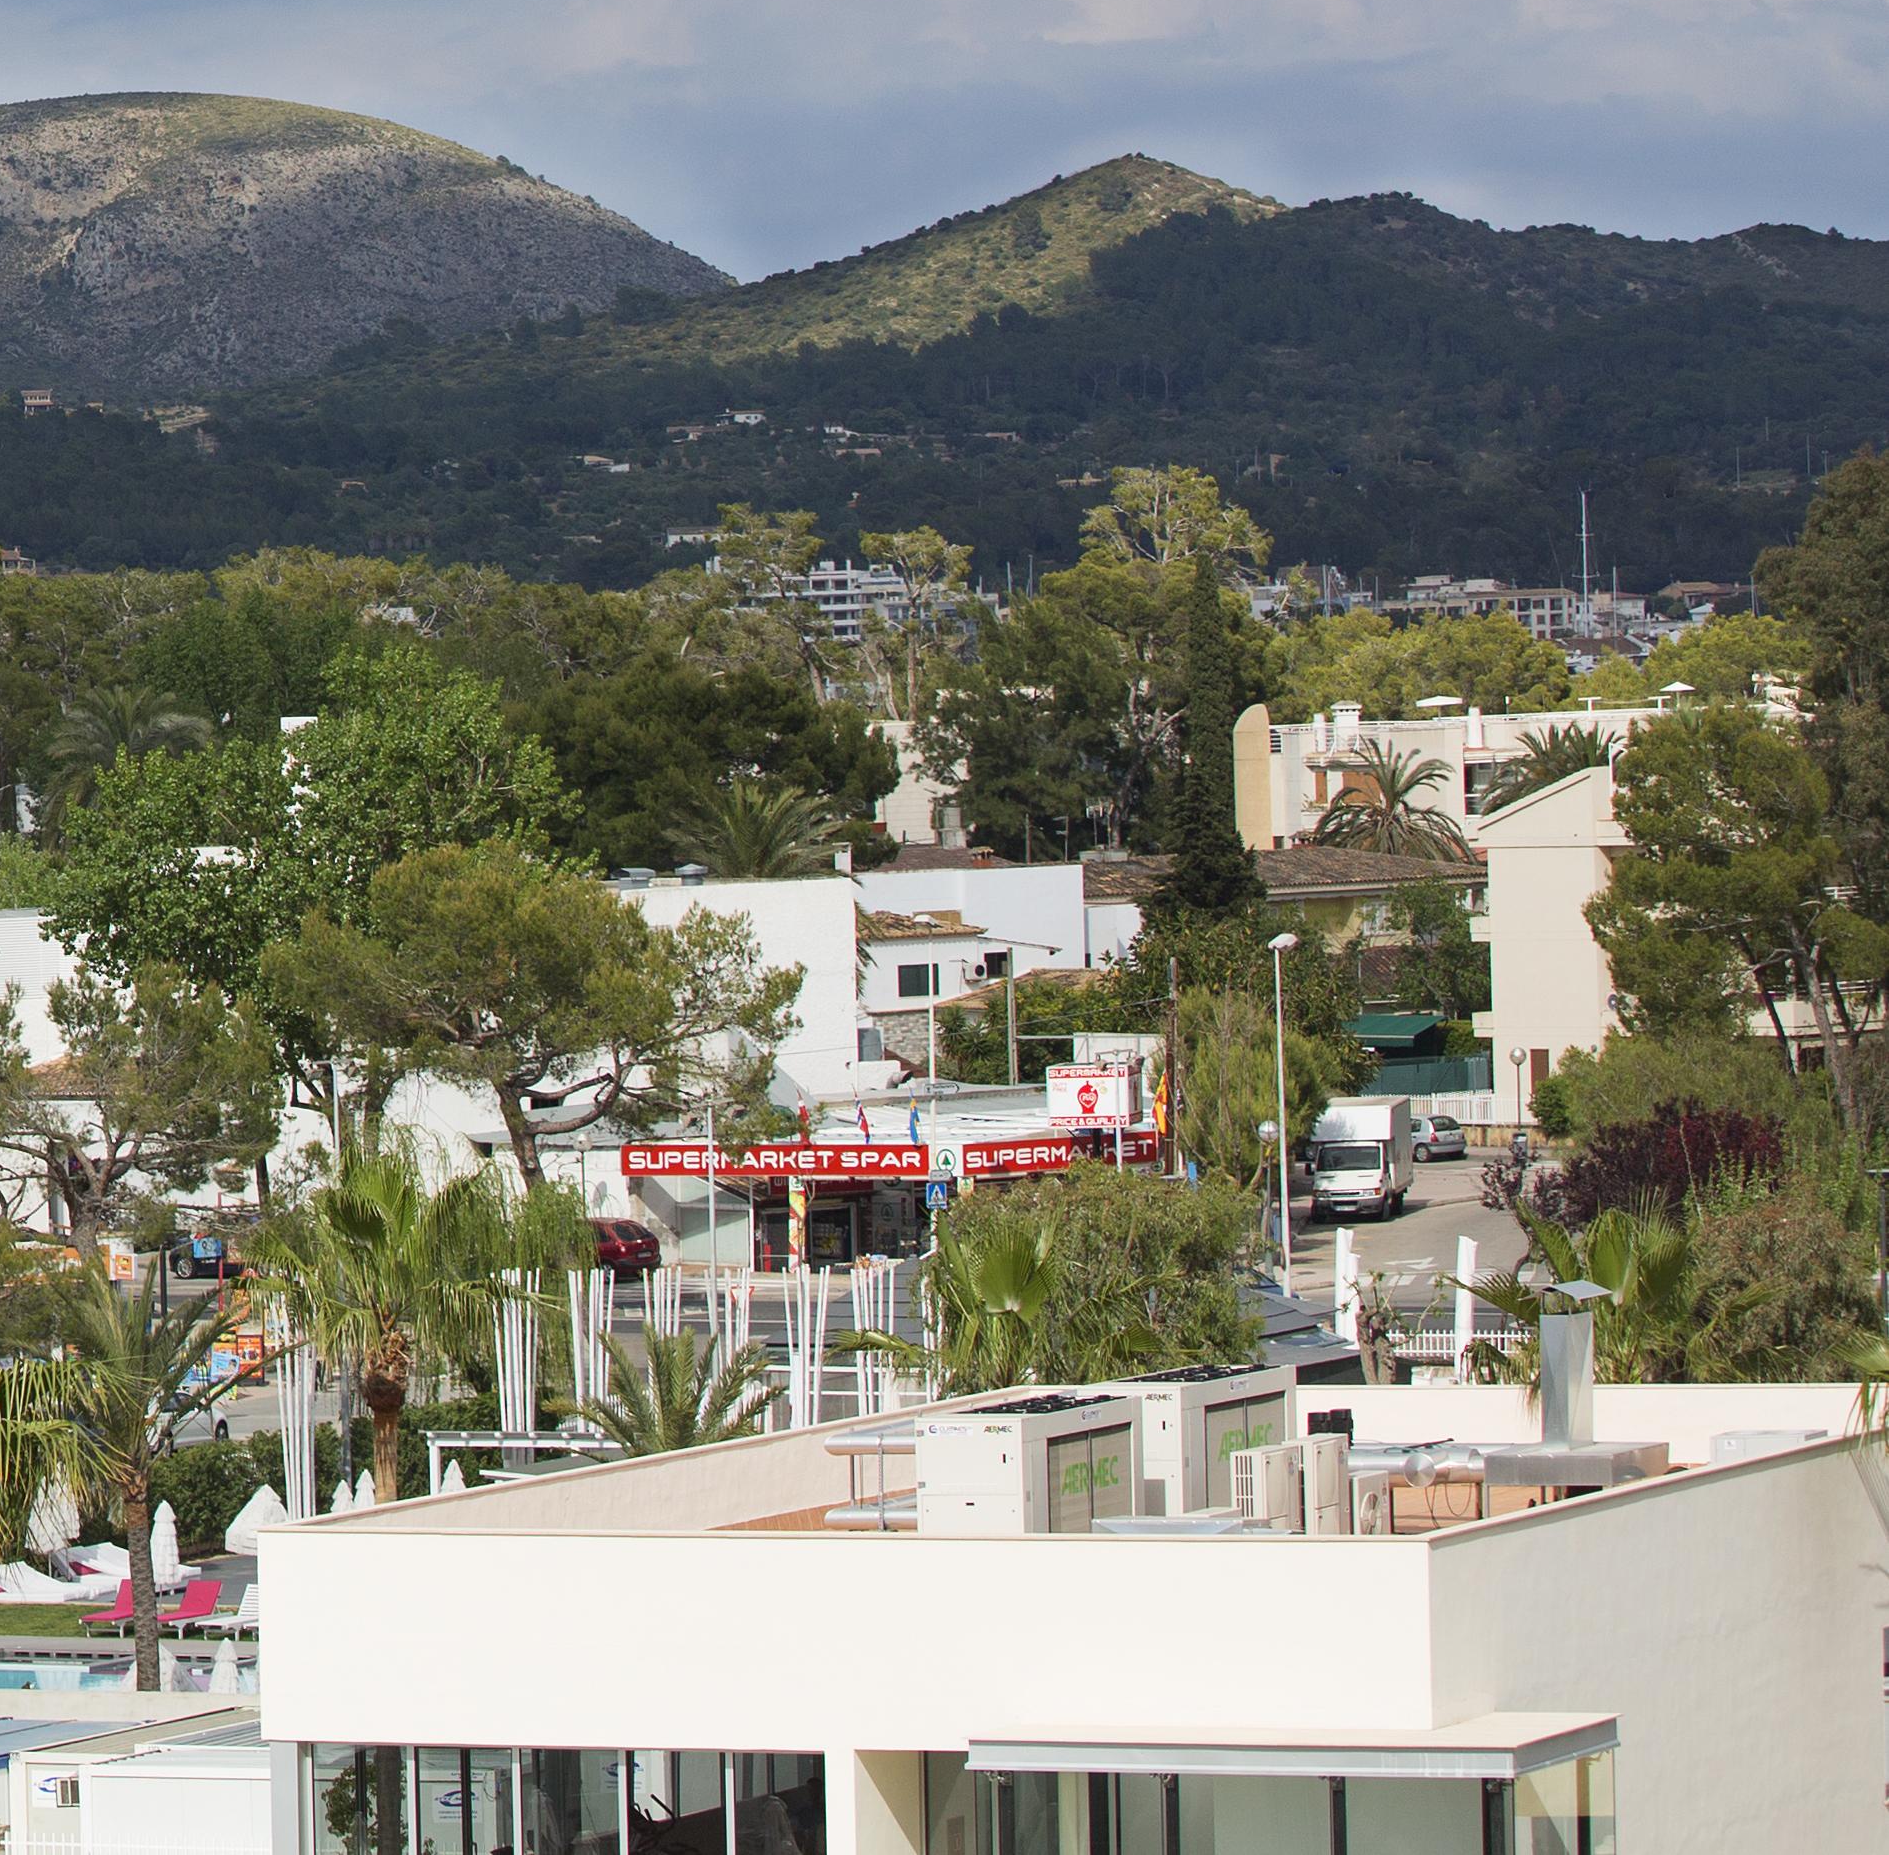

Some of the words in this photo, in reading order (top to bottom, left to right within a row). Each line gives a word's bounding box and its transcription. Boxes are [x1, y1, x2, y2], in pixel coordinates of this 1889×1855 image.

[1048, 1068, 1126, 1078] SUPERMARKET
[628, 1151, 834, 1169] SUPERMARKET
[840, 1151, 921, 1168] SPAR
[1145, 1393, 1173, 1402] AERMEC
[983, 1425, 1013, 1435] AERMEC
[1061, 1455, 1119, 1495] AERMEC
